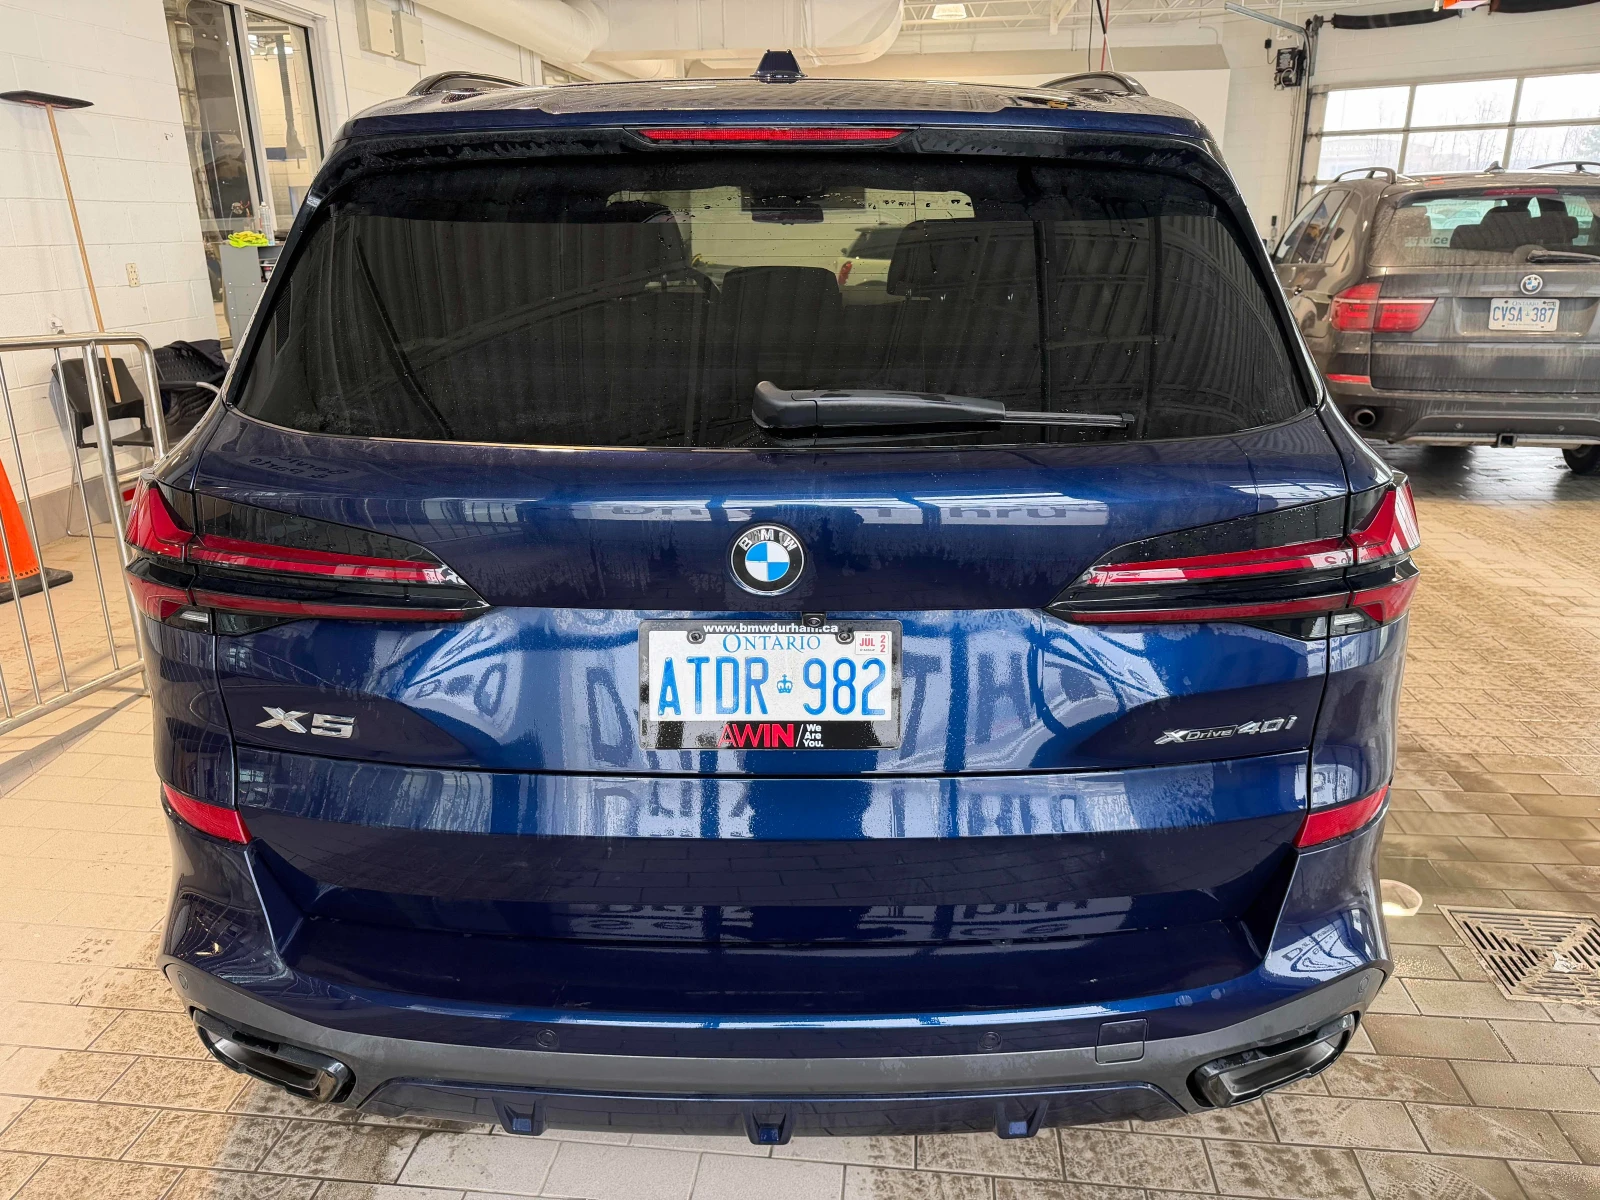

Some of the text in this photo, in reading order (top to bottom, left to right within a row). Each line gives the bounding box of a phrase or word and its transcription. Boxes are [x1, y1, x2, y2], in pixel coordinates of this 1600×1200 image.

[1493, 306, 1555, 322] CVSA 387
[738, 528, 798, 552] BMW
[703, 623, 839, 633] www.bmwdurham.ca
[859, 637, 876, 647] JUL
[658, 656, 769, 715] ATDR
[803, 657, 886, 715] 982
[255, 706, 356, 739] X5
[806, 723, 822, 732] We
[717, 723, 794, 748] AWIN
[804, 731, 822, 740] Are
[803, 739, 824, 748] You.
